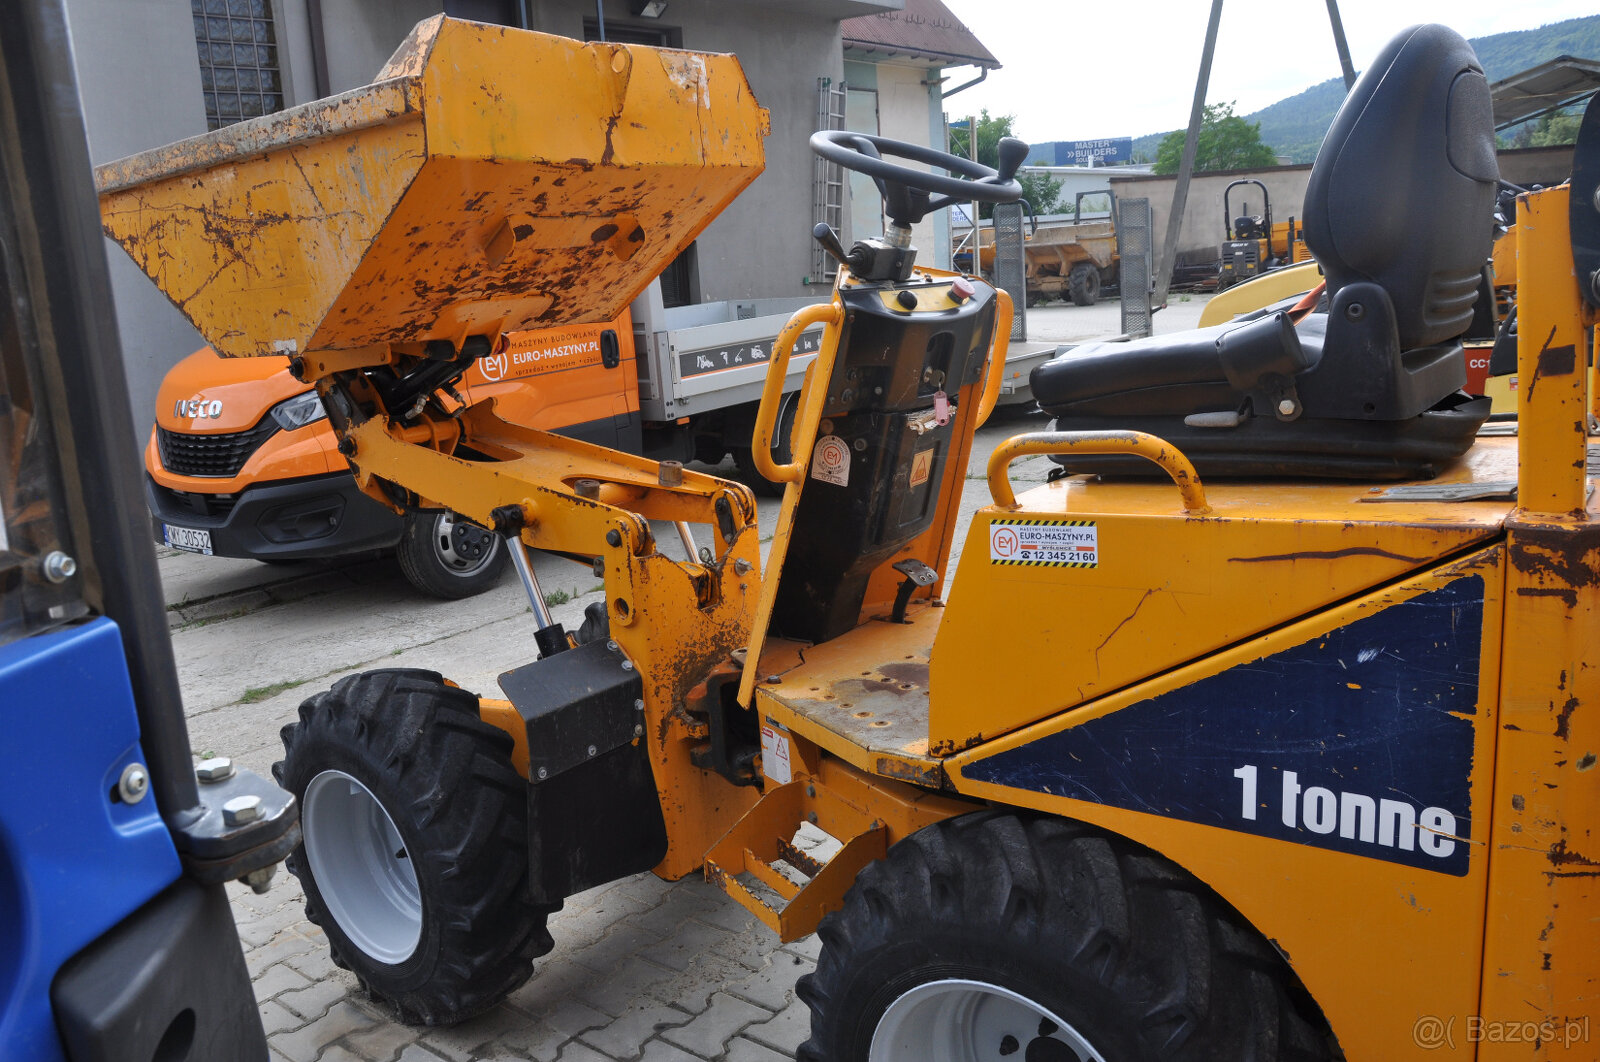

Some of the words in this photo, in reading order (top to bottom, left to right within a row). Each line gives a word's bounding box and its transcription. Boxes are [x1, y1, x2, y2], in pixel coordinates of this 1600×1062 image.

[1075, 147, 1117, 157] BUILDERS
[511, 337, 548, 349] MASZYNY
[551, 330, 598, 343] BUDOWLANE
[513, 341, 600, 364] EURO-MASZYNY.PL
[173, 399, 223, 419] IVECO
[182, 529, 211, 549] 30532
[1020, 532, 1095, 541] EURO-MASZYNY.PL
[1033, 551, 1045, 559] 12
[1047, 551, 1067, 560] 345
[1068, 552, 1080, 561] 21
[1082, 552, 1095, 561] 60
[1233, 764, 1257, 821] 1
[1281, 770, 1457, 858] tonne
